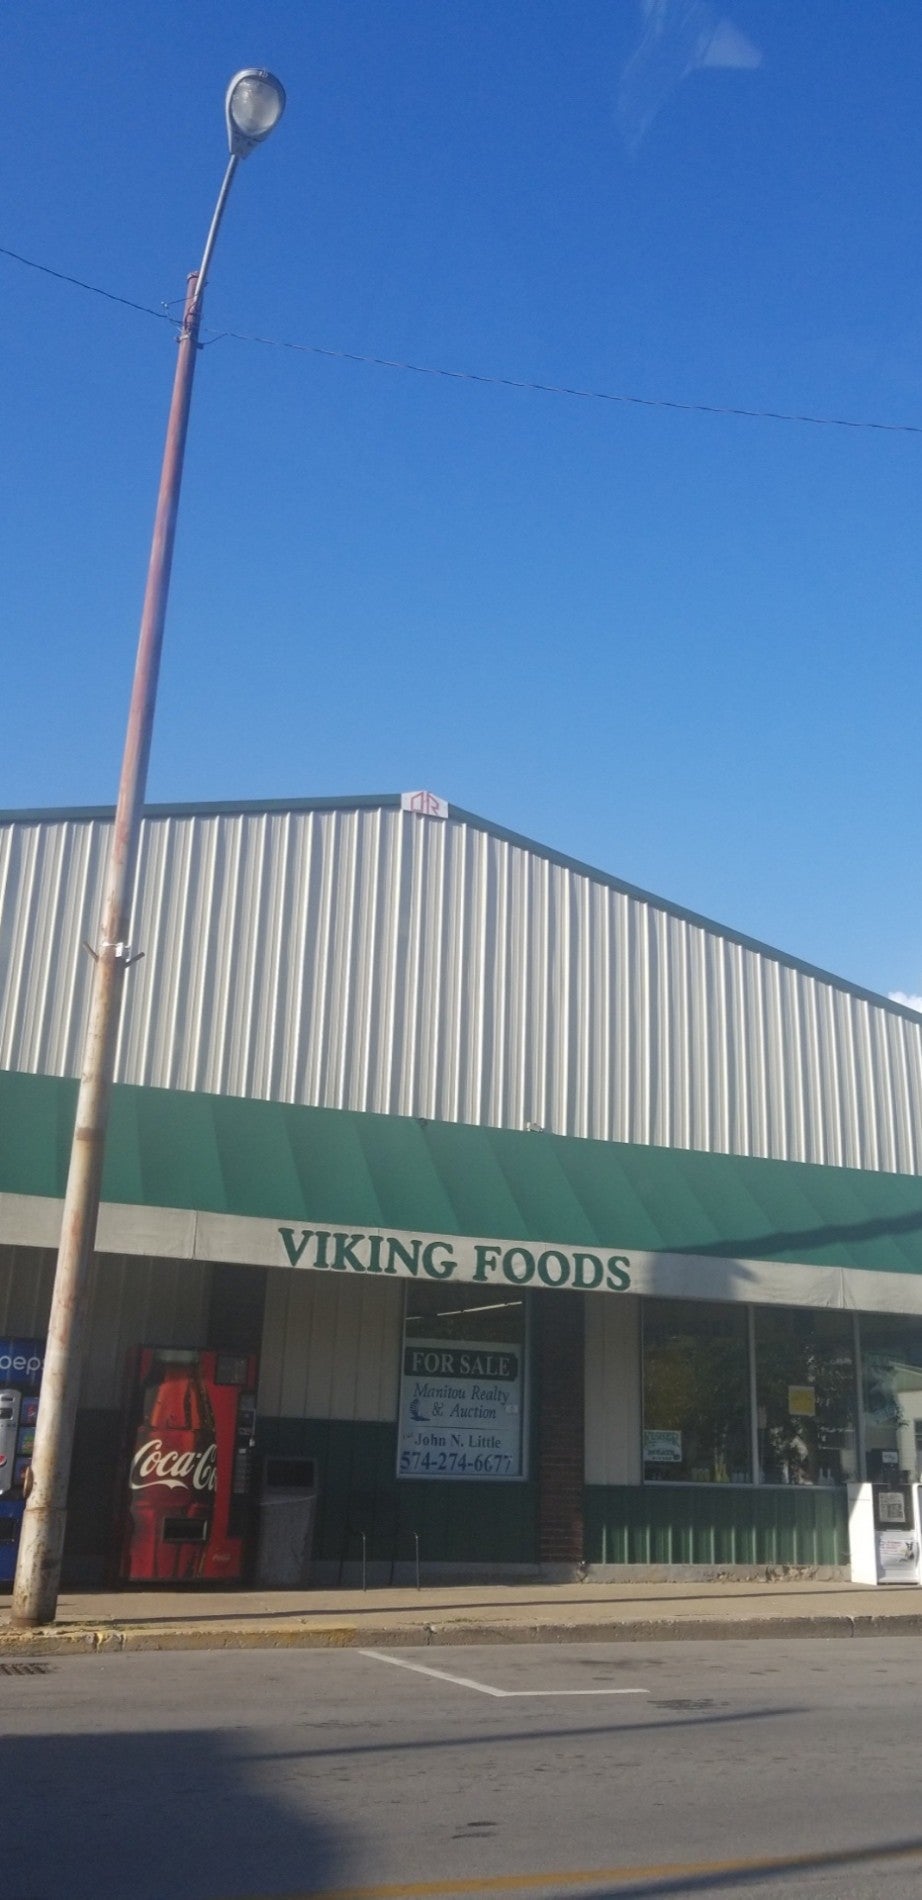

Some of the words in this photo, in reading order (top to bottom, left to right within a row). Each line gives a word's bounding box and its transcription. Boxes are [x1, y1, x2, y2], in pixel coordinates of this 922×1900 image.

[278, 1227, 457, 1279] VIKING
[473, 1245, 631, 1291] FOODS
[412, 1351, 454, 1373] FOR
[460, 1354, 510, 1376] SALE
[413, 1383, 466, 1399] Manitou
[471, 1385, 510, 1405] Realty
[432, 1402, 444, 1416] &
[449, 1404, 496, 1419] Auction
[414, 1434, 446, 1447] John
[468, 1435, 502, 1449] Little
[400, 1451, 513, 1472] 574-274-6677
